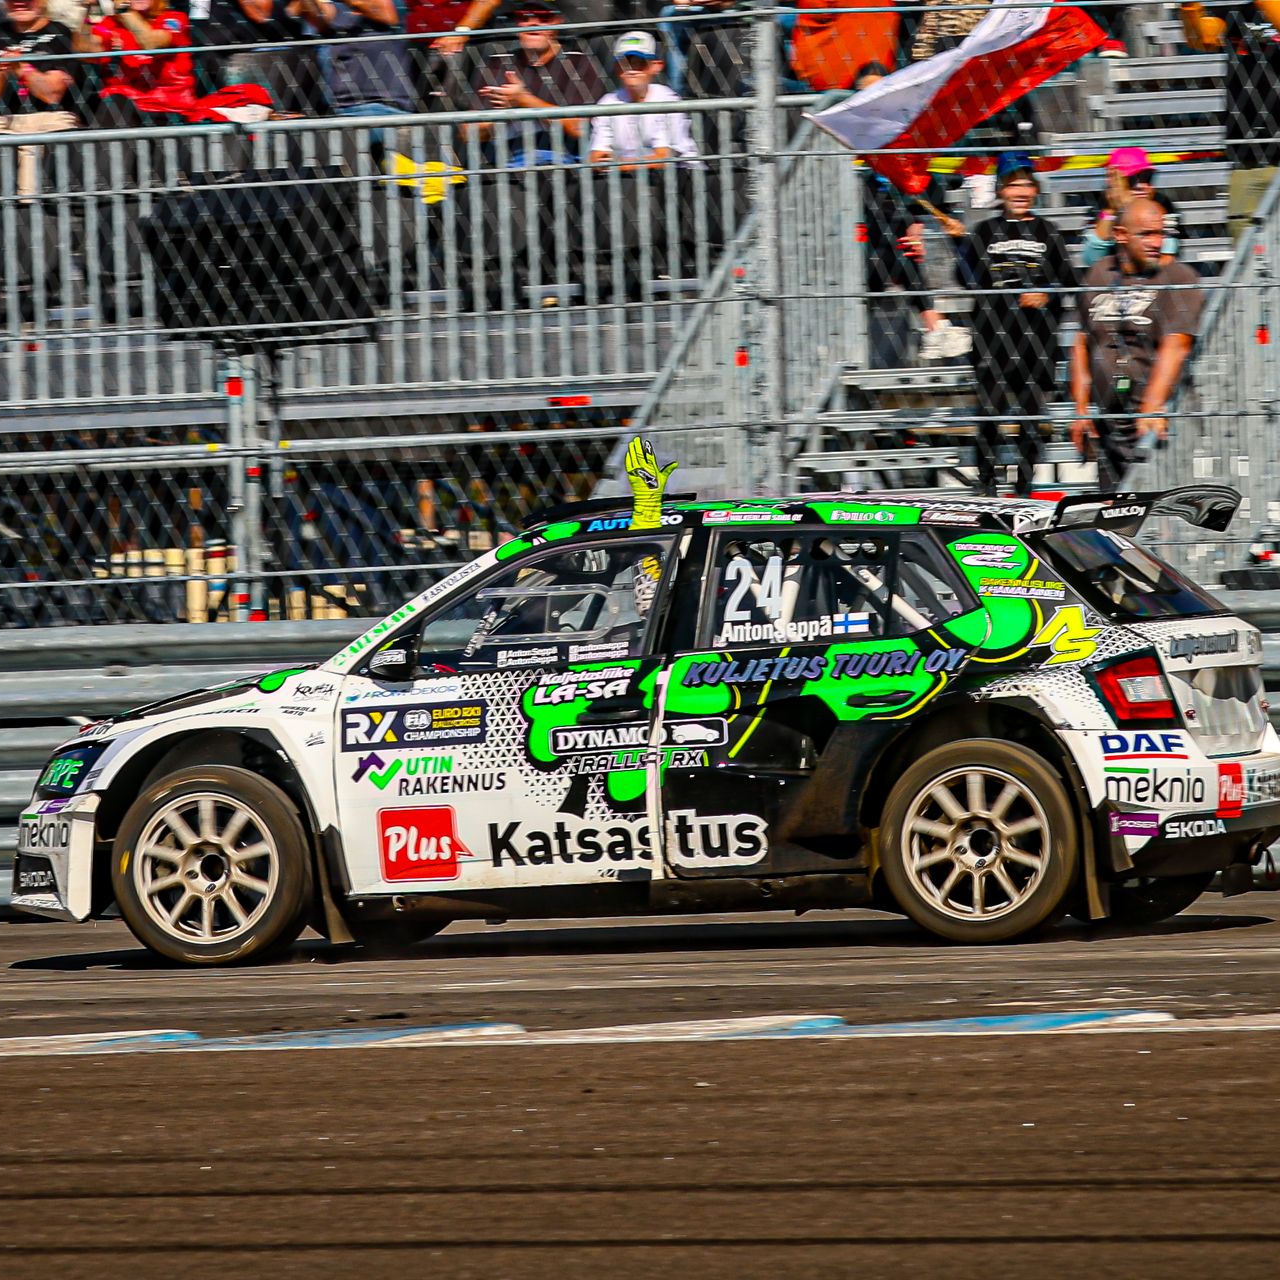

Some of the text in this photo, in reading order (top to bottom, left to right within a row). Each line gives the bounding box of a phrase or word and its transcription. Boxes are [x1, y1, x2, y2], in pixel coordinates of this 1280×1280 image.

[723, 555, 784, 621] 24
[683, 648, 967, 685] KULJETUS TUURI OY
[534, 679, 630, 704] LA-SA
[346, 711, 398, 745] RX
[403, 727, 481, 741] CHAMPIONSHIP
[1099, 734, 1184, 754] DAF
[406, 755, 453, 775] UTIN
[670, 750, 705, 767] RX
[398, 772, 507, 796] RAKENNUS
[1165, 819, 1227, 839] SKODA
[384, 824, 453, 863] Plus
